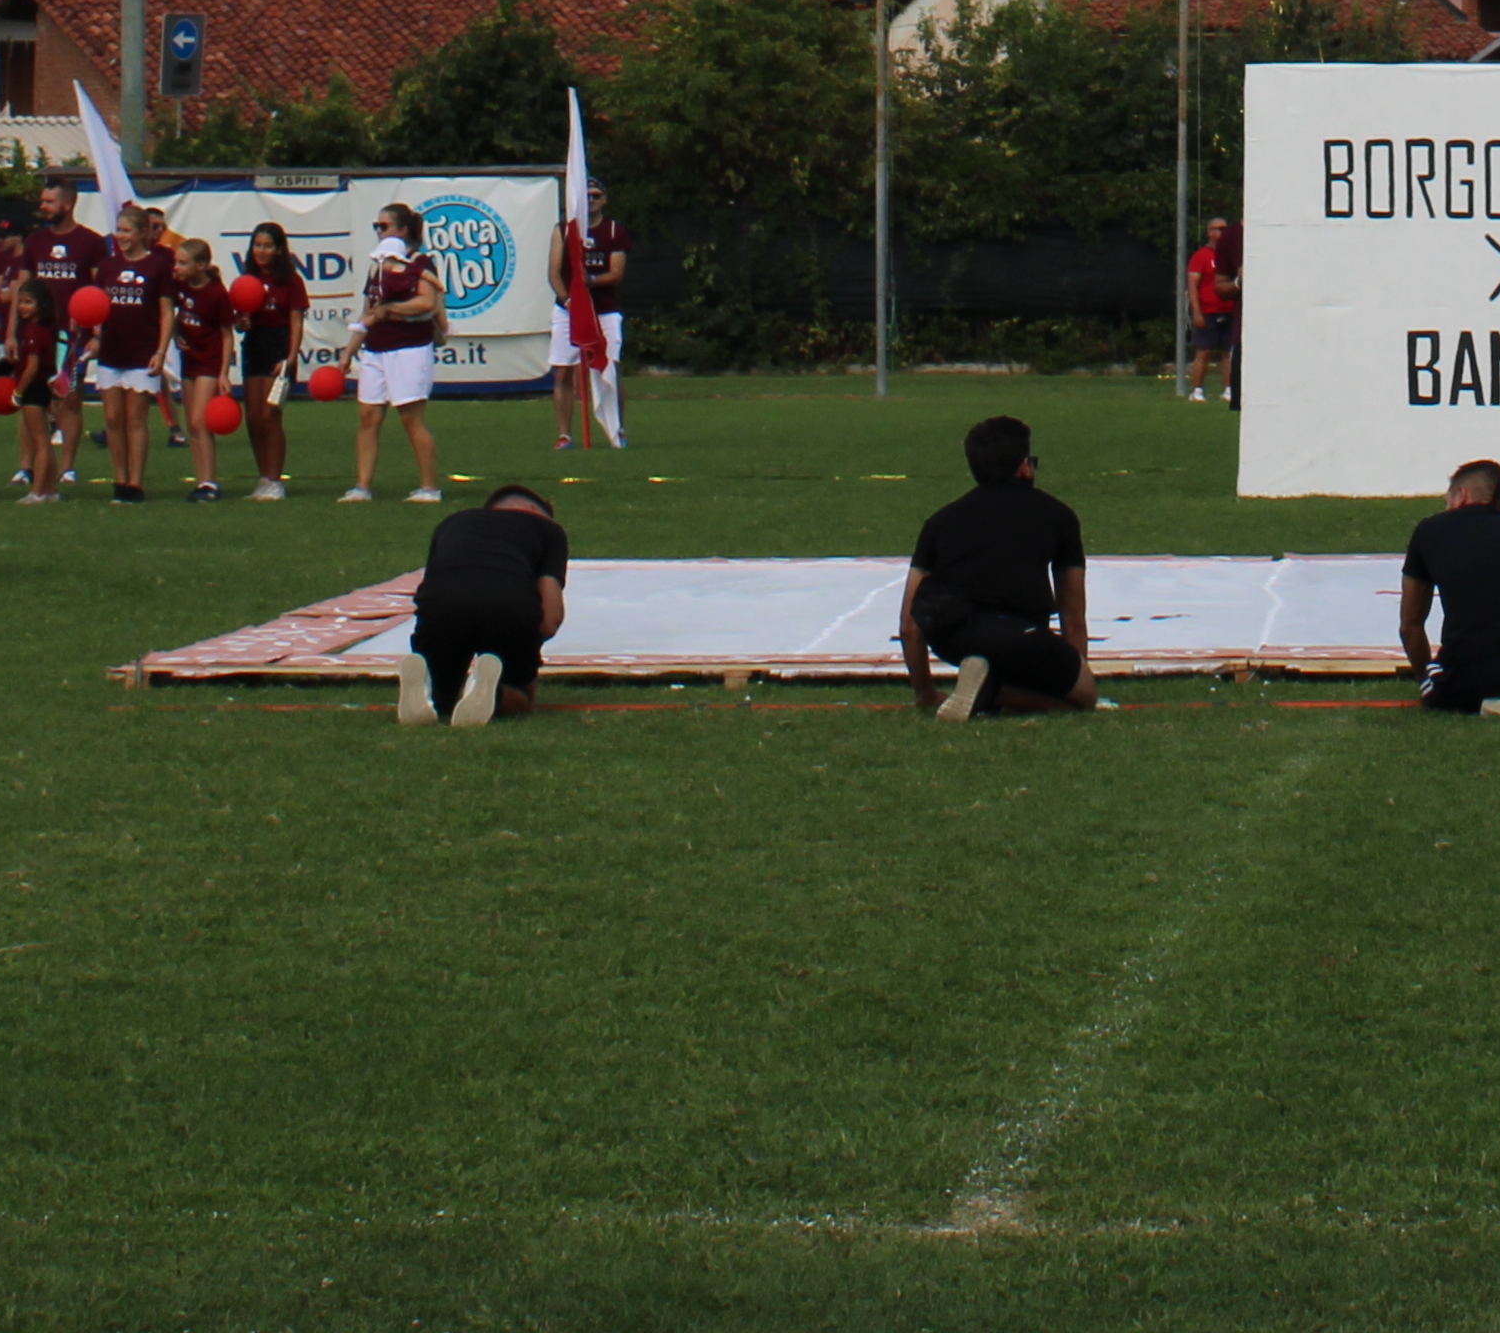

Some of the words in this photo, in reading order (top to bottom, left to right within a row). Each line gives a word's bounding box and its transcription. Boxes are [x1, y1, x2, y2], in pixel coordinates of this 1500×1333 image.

[276, 176, 319, 187] OSPITI
[422, 215, 498, 251] Tocca
[37, 262, 78, 271] BORGO
[37, 270, 77, 279] MACRA
[108, 295, 143, 305] ACRA
